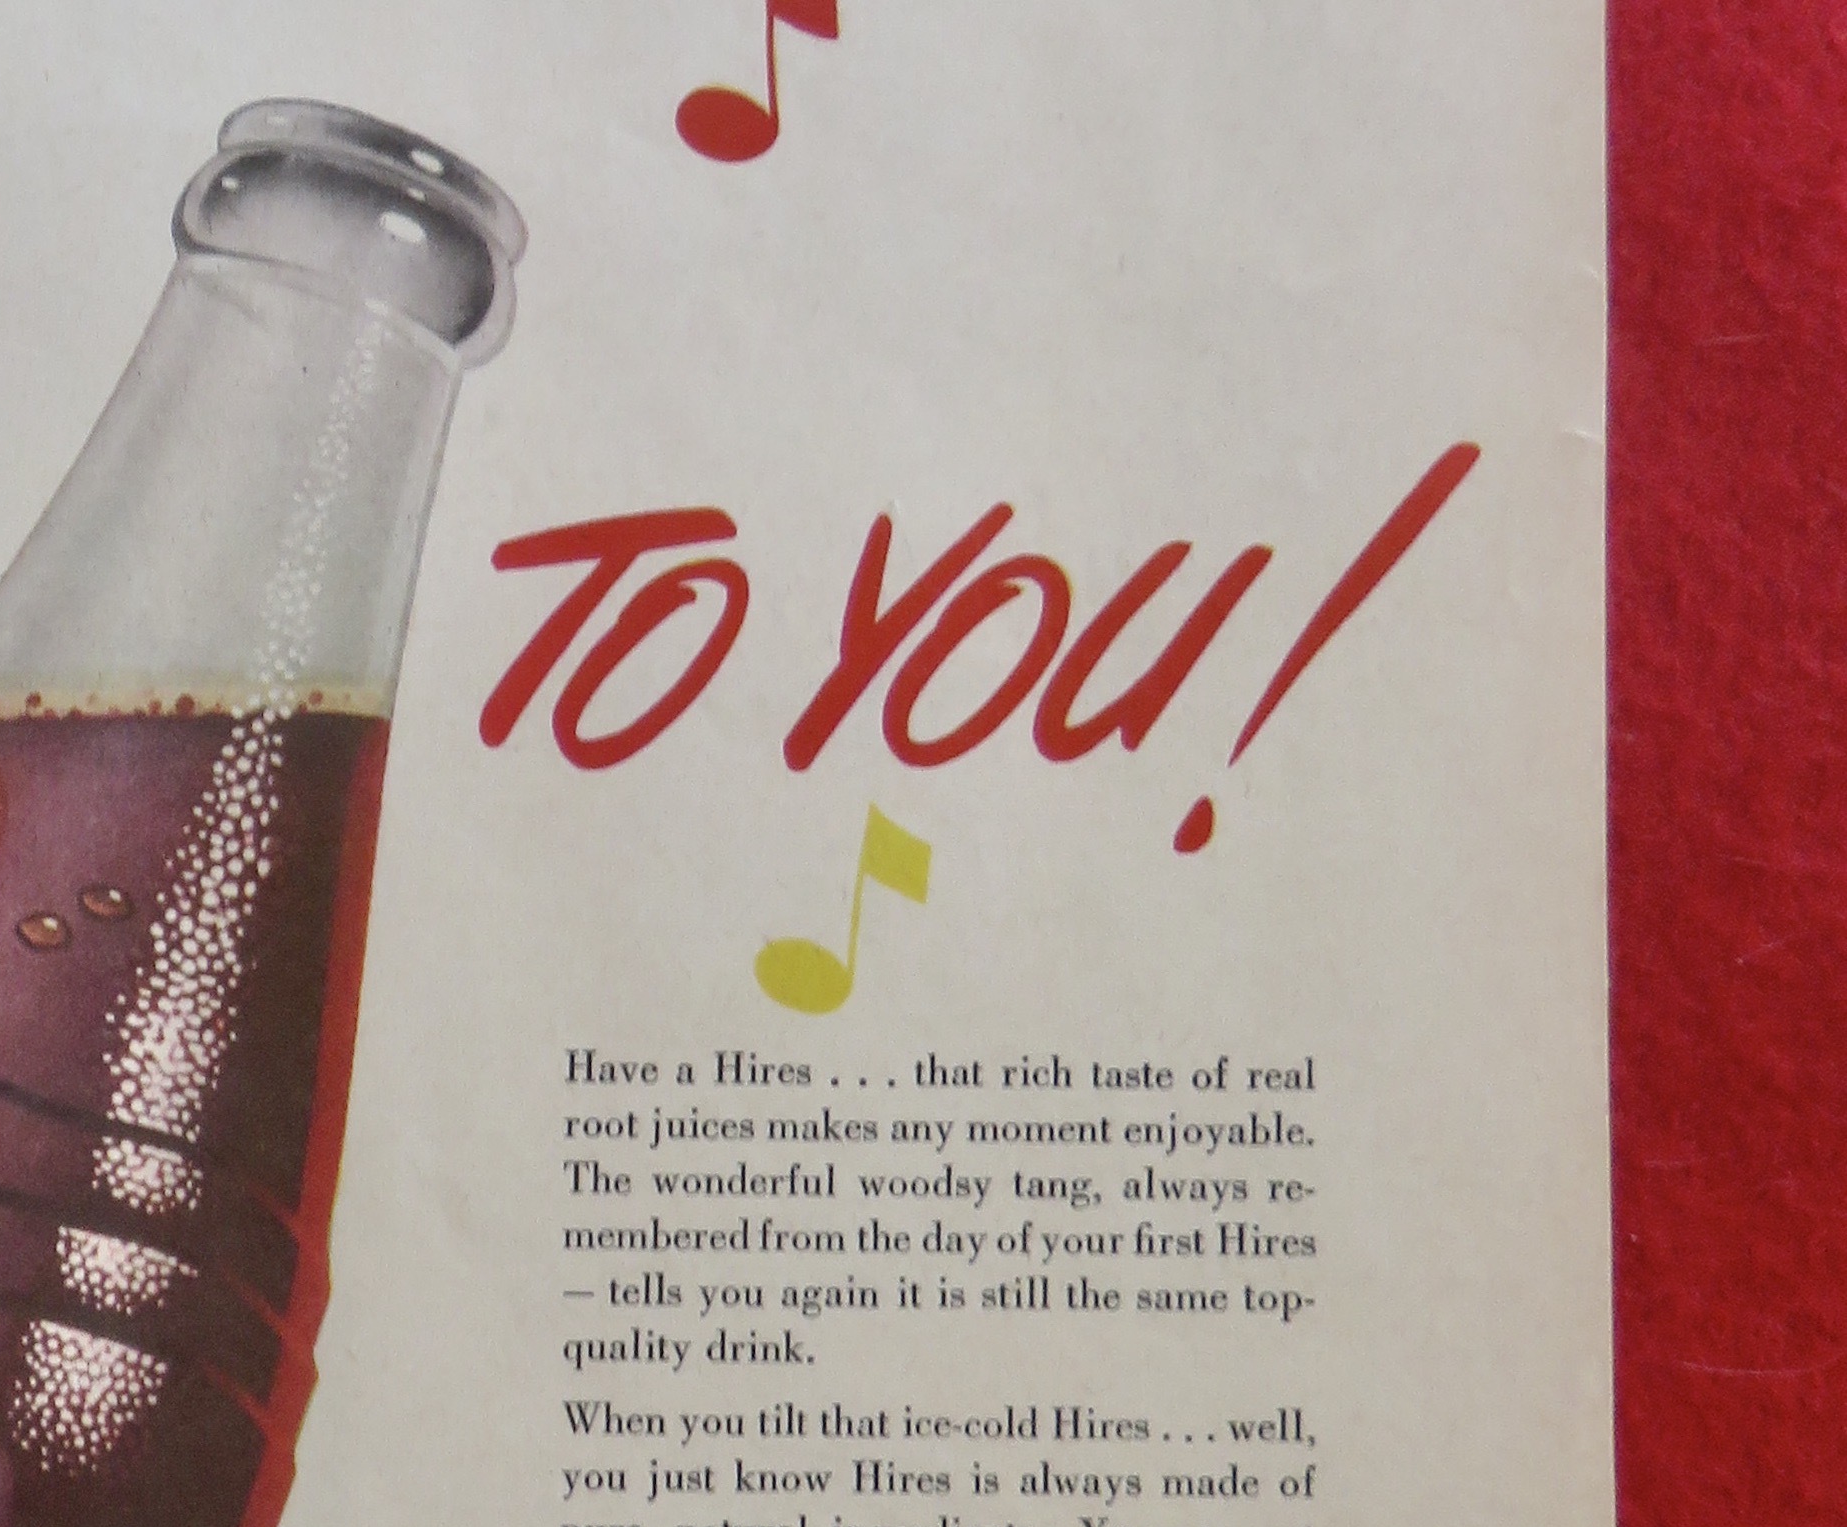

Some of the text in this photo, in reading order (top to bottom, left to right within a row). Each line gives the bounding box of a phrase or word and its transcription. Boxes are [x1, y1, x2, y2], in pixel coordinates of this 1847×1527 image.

[478, 505, 750, 771] TO
[782, 440, 1481, 854] YOU!
[564, 1048, 659, 1085] Have
[675, 1062, 696, 1086] a
[714, 1050, 812, 1086] Hires
[914, 1051, 984, 1088] that
[1002, 1053, 1073, 1089] rich
[1091, 1061, 1174, 1091] taste
[1191, 1054, 1230, 1091] of
[1247, 1056, 1316, 1091] real
[565, 1106, 1315, 1156] root juices makes any moment enjoyable.
[562, 1159, 1315, 1212] The wonderful woodsy tang, always re-
[563, 1216, 1318, 1265] membered from the day of your first Hires
[609, 1271, 683, 1307] tells
[699, 1285, 764, 1318] you
[780, 1274, 879, 1318] again
[899, 1275, 922, 1310] it
[939, 1275, 966, 1309] is
[981, 1275, 1051, 1311] still
[1066, 1275, 1121, 1311] the
[1136, 1289, 1229, 1313] same
[1243, 1284, 1316, 1324] top-
[562, 1326, 815, 1373] quality drink.
[563, 1400, 666, 1437] When
[679, 1414, 745, 1447] you
[758, 1401, 807, 1438] tilt
[820, 1402, 890, 1439] that
[903, 1404, 1039, 1440] ice-cold
[1053, 1405, 1151, 1441] Hires
[1227, 1407, 1316, 1448] well,
[562, 1457, 1317, 1506] you just know Hires is always made of
